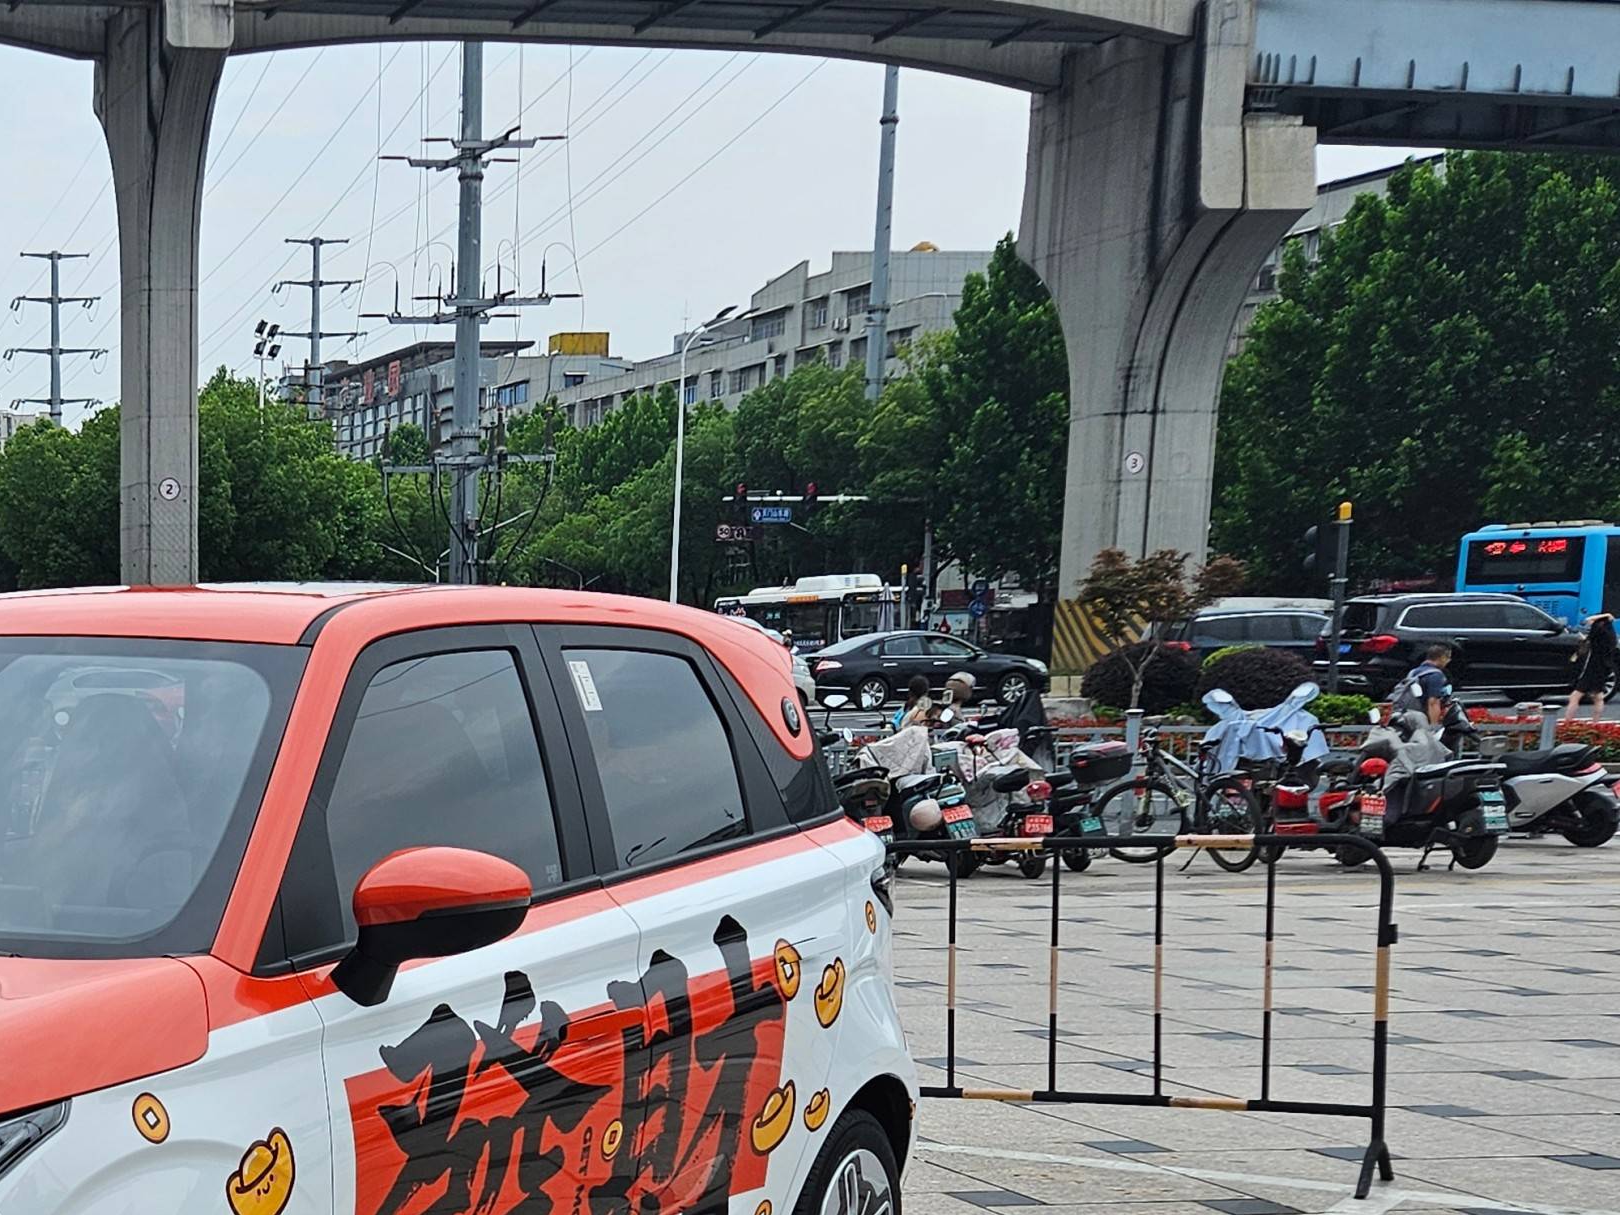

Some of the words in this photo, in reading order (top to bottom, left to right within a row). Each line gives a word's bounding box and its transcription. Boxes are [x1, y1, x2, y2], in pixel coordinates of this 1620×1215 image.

[1130, 457, 1138, 469] 3
[166, 483, 173, 495] 2
[579, 1125, 593, 1177] GET
